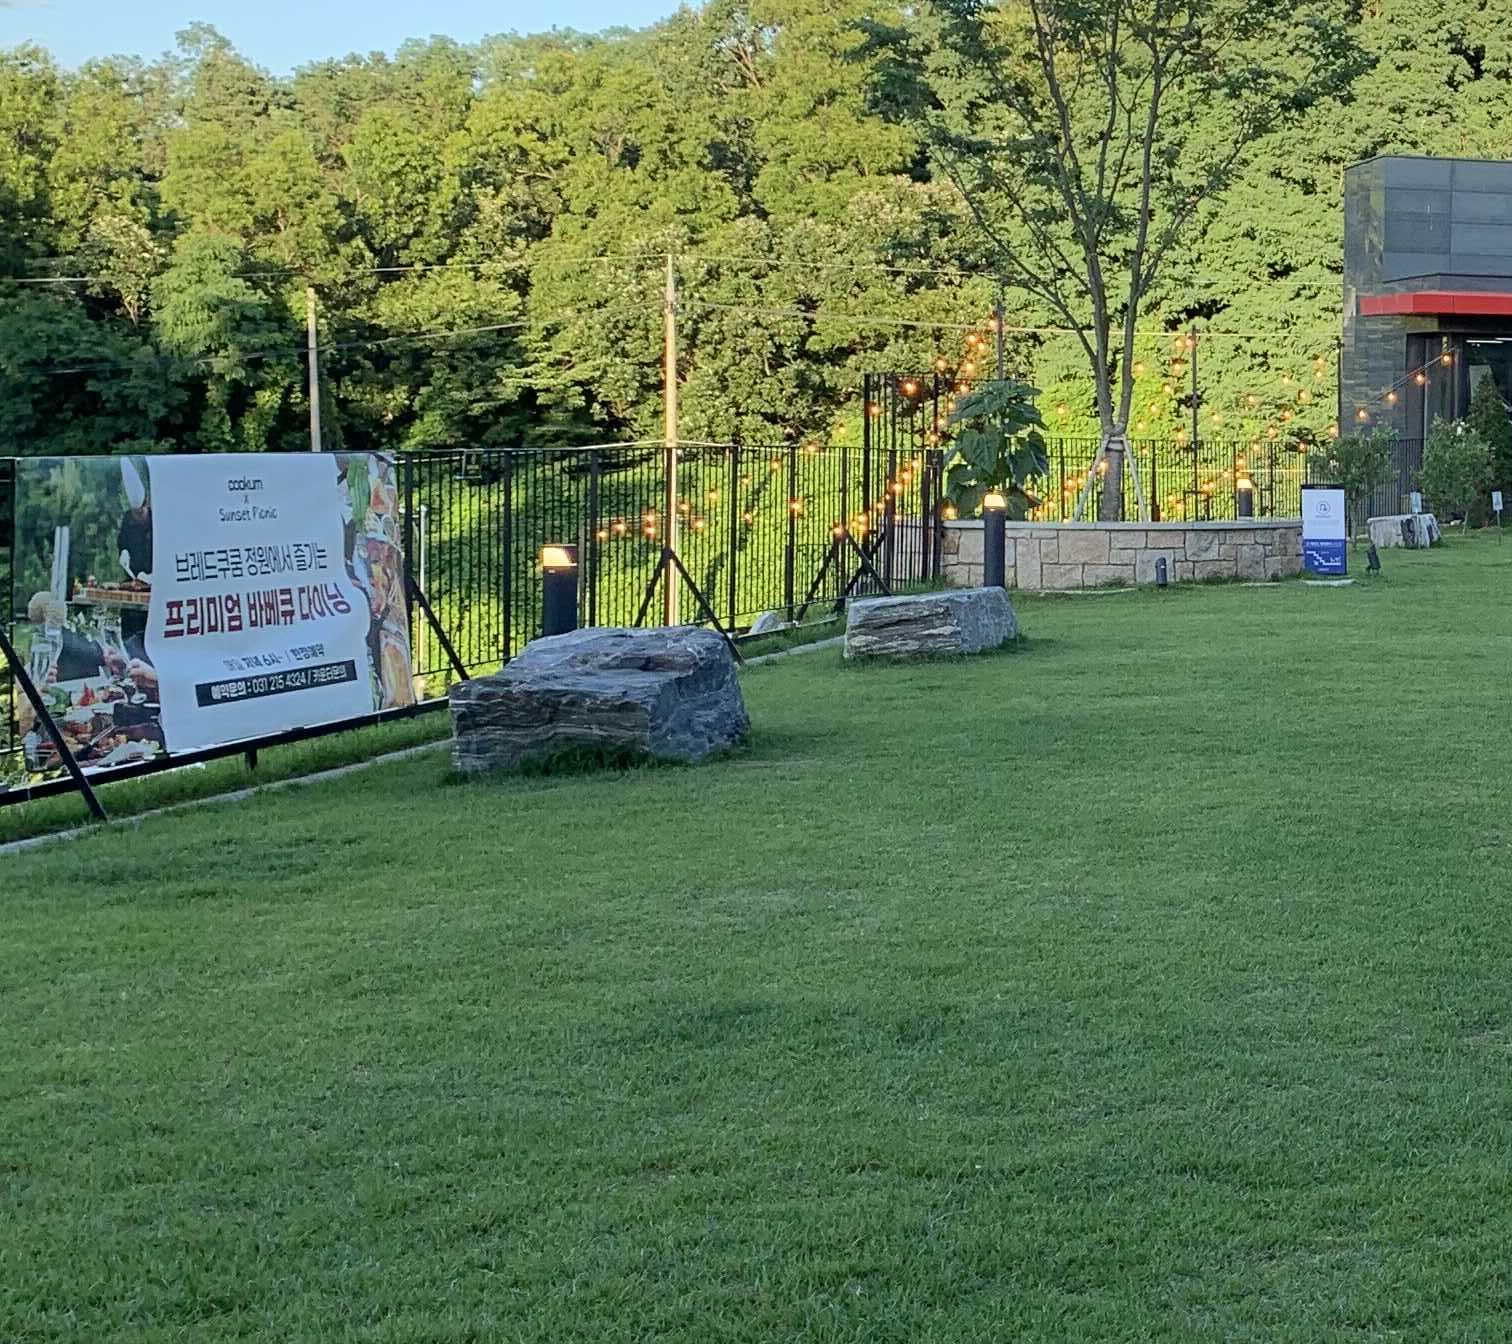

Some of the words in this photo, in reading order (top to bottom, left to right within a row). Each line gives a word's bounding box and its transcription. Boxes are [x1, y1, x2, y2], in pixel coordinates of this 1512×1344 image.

[218, 508, 251, 522] Sunset
[252, 506, 278, 520] Picnic
[175, 548, 243, 582] 브레드쿠쿰
[244, 544, 293, 576] 정원에서
[293, 542, 327, 571] 즐기는
[163, 593, 243, 638] 프리미엄
[246, 587, 296, 628] 바베큐
[297, 582, 351, 620] 다이닝
[252, 677, 268, 693] 031
